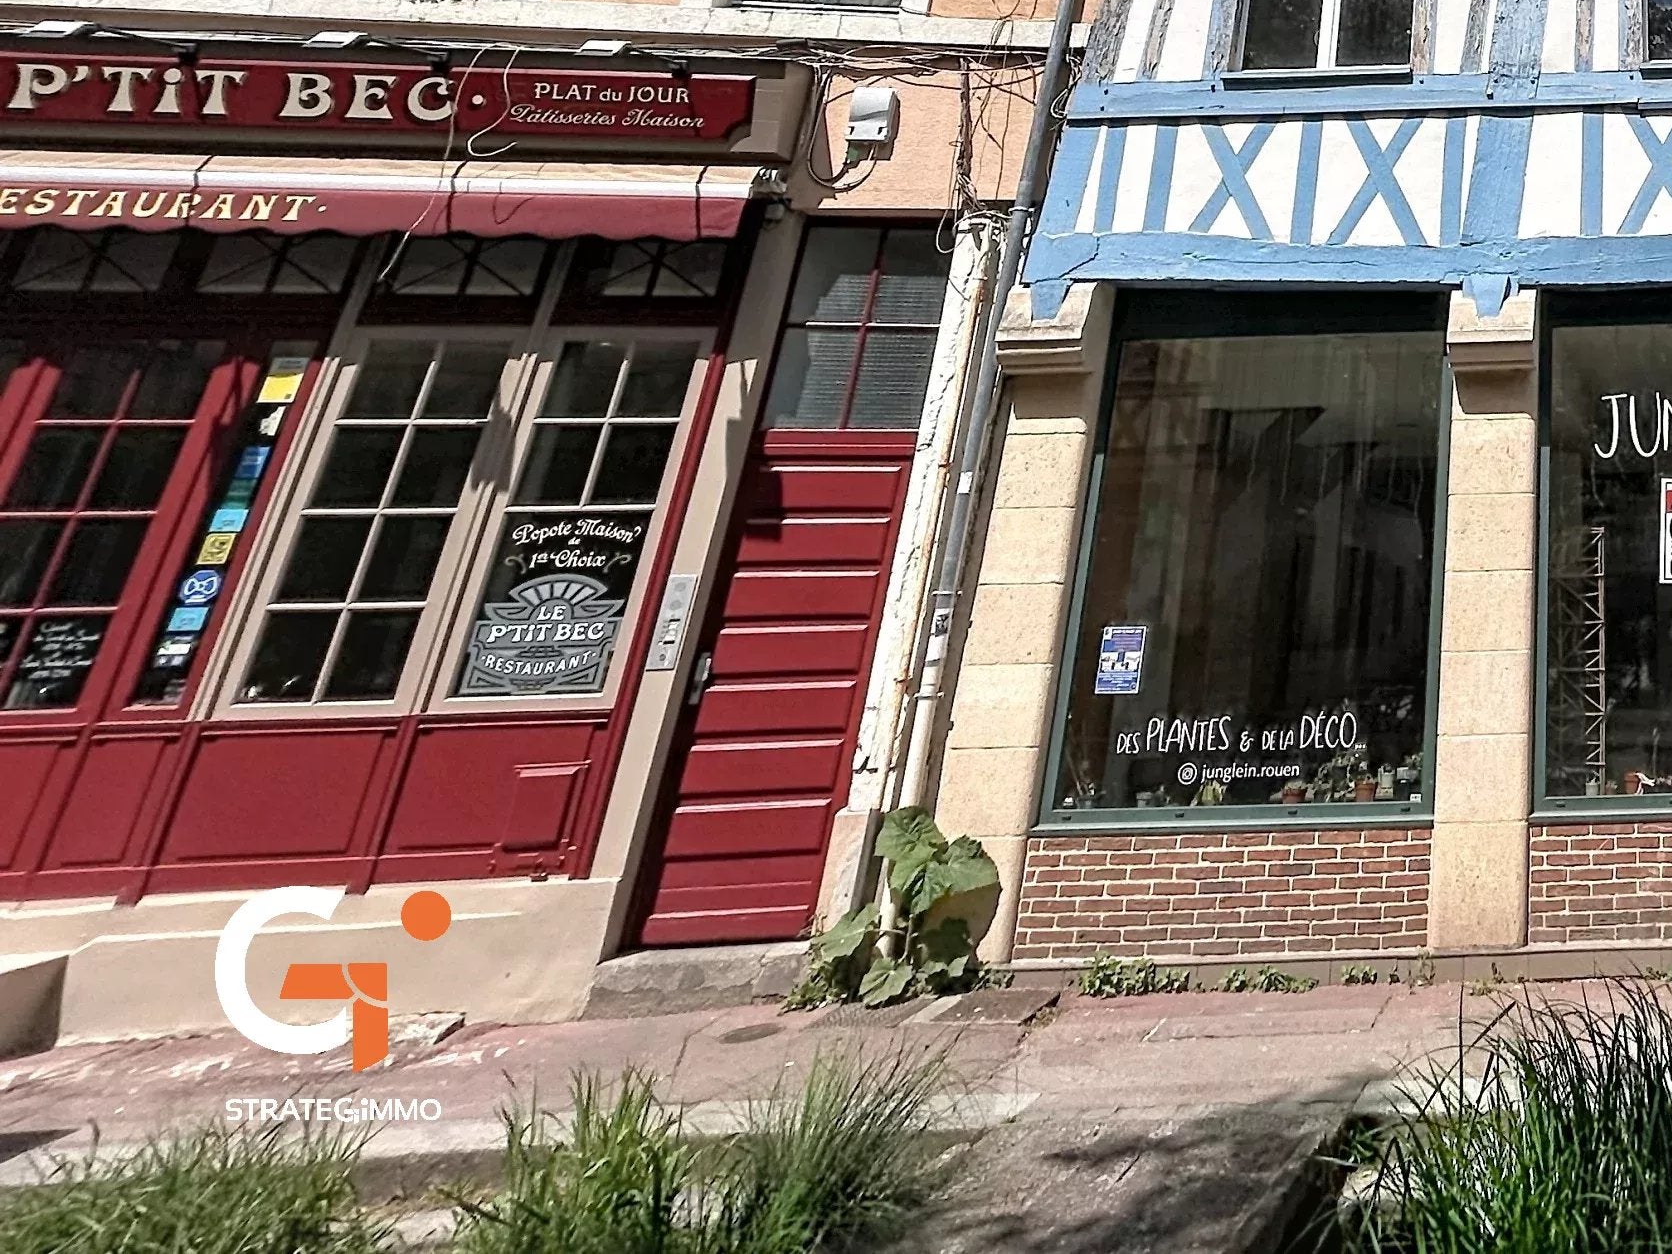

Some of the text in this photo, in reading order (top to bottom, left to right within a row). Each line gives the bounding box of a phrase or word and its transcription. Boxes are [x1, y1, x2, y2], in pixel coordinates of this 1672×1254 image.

[534, 82, 689, 103] PLAT du JOUR
[510, 103, 705, 129] Pâtisseries Maison
[512, 518, 642, 546] Popote Maison
[568, 536, 581, 545] de
[549, 549, 606, 569] Choix
[537, 605, 567, 621] LE
[553, 622, 605, 642] BEC
[1116, 732, 1141, 754] DES
[1146, 715, 1232, 754] PLANTES
[1239, 731, 1254, 752] &
[1262, 730, 1276, 751] DE
[1279, 730, 1294, 751] LA
